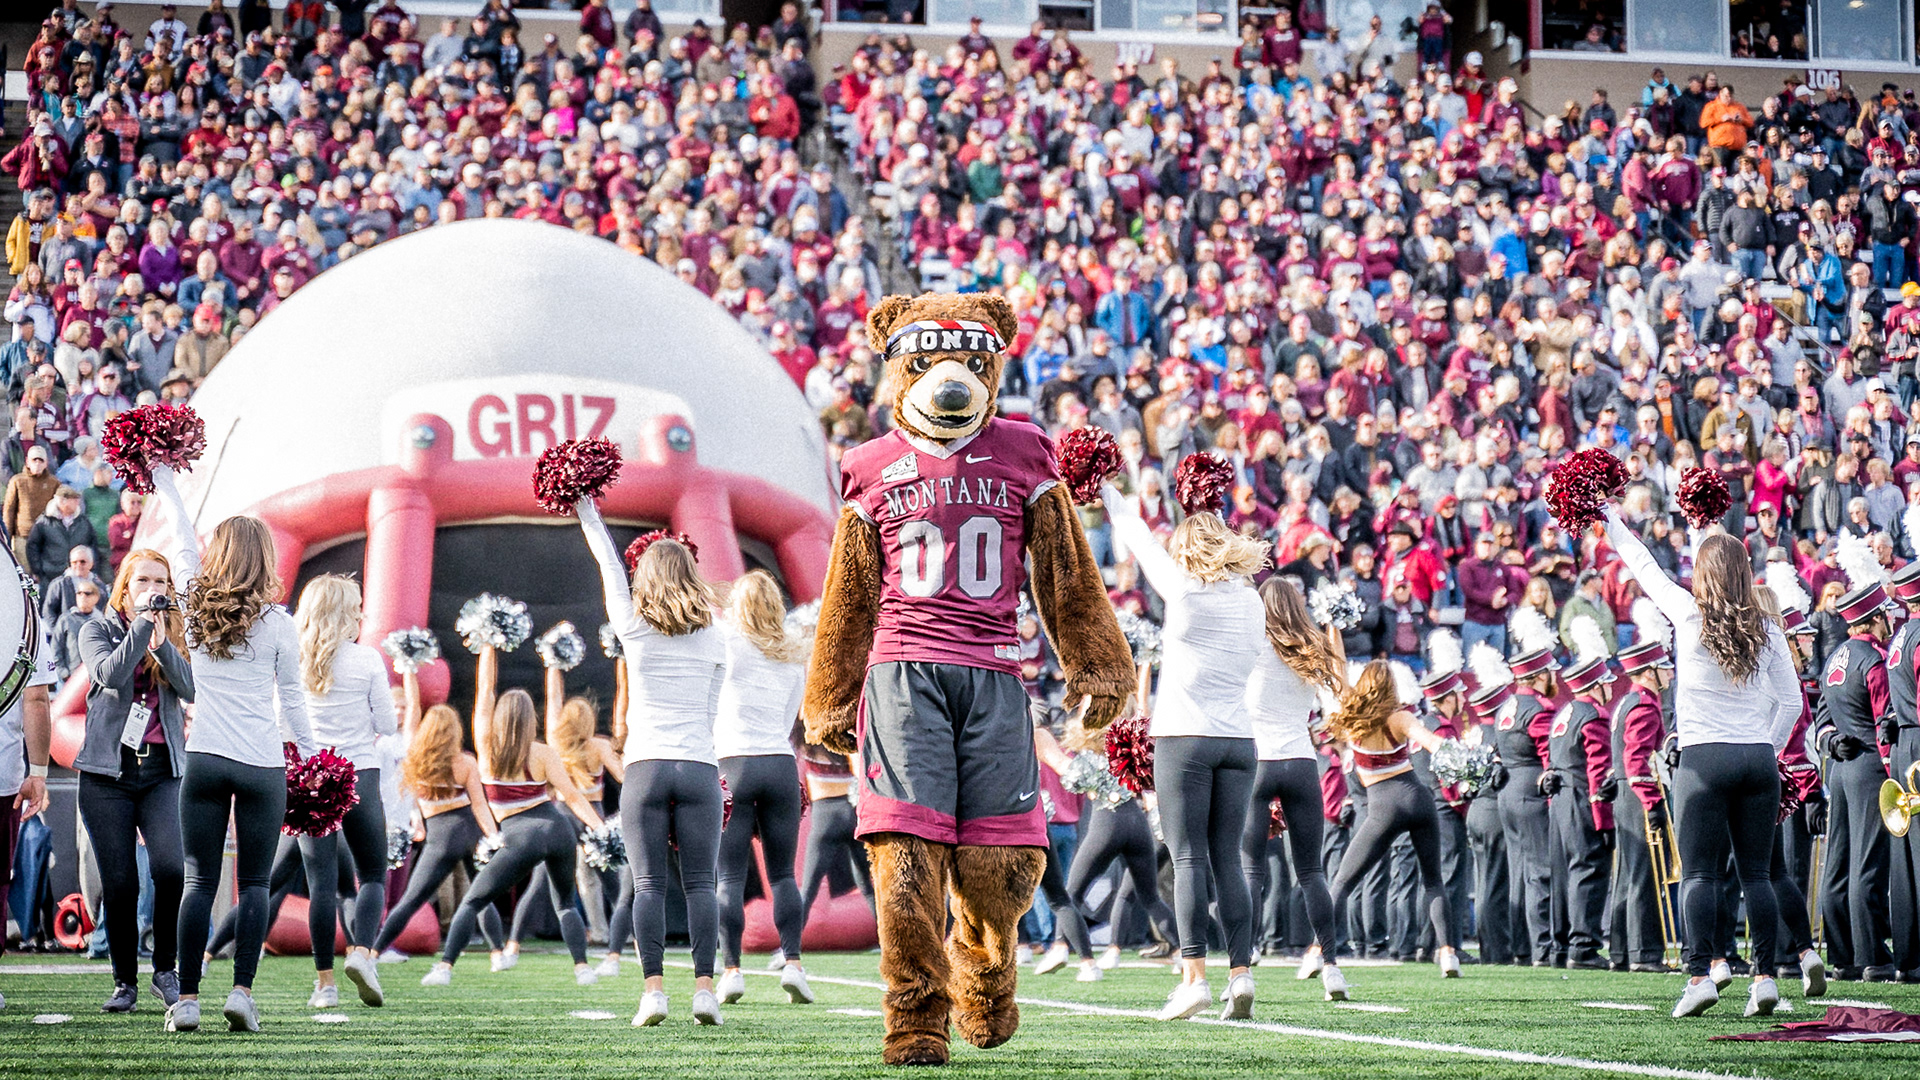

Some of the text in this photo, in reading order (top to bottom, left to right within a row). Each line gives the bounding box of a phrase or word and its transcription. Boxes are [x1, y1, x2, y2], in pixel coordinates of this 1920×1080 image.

[1807, 69, 1840, 90] 106
[899, 330, 997, 355] MONTE
[468, 393, 617, 458] GRIZ
[883, 475, 1009, 518] MONTANA
[899, 516, 1003, 599] 00
